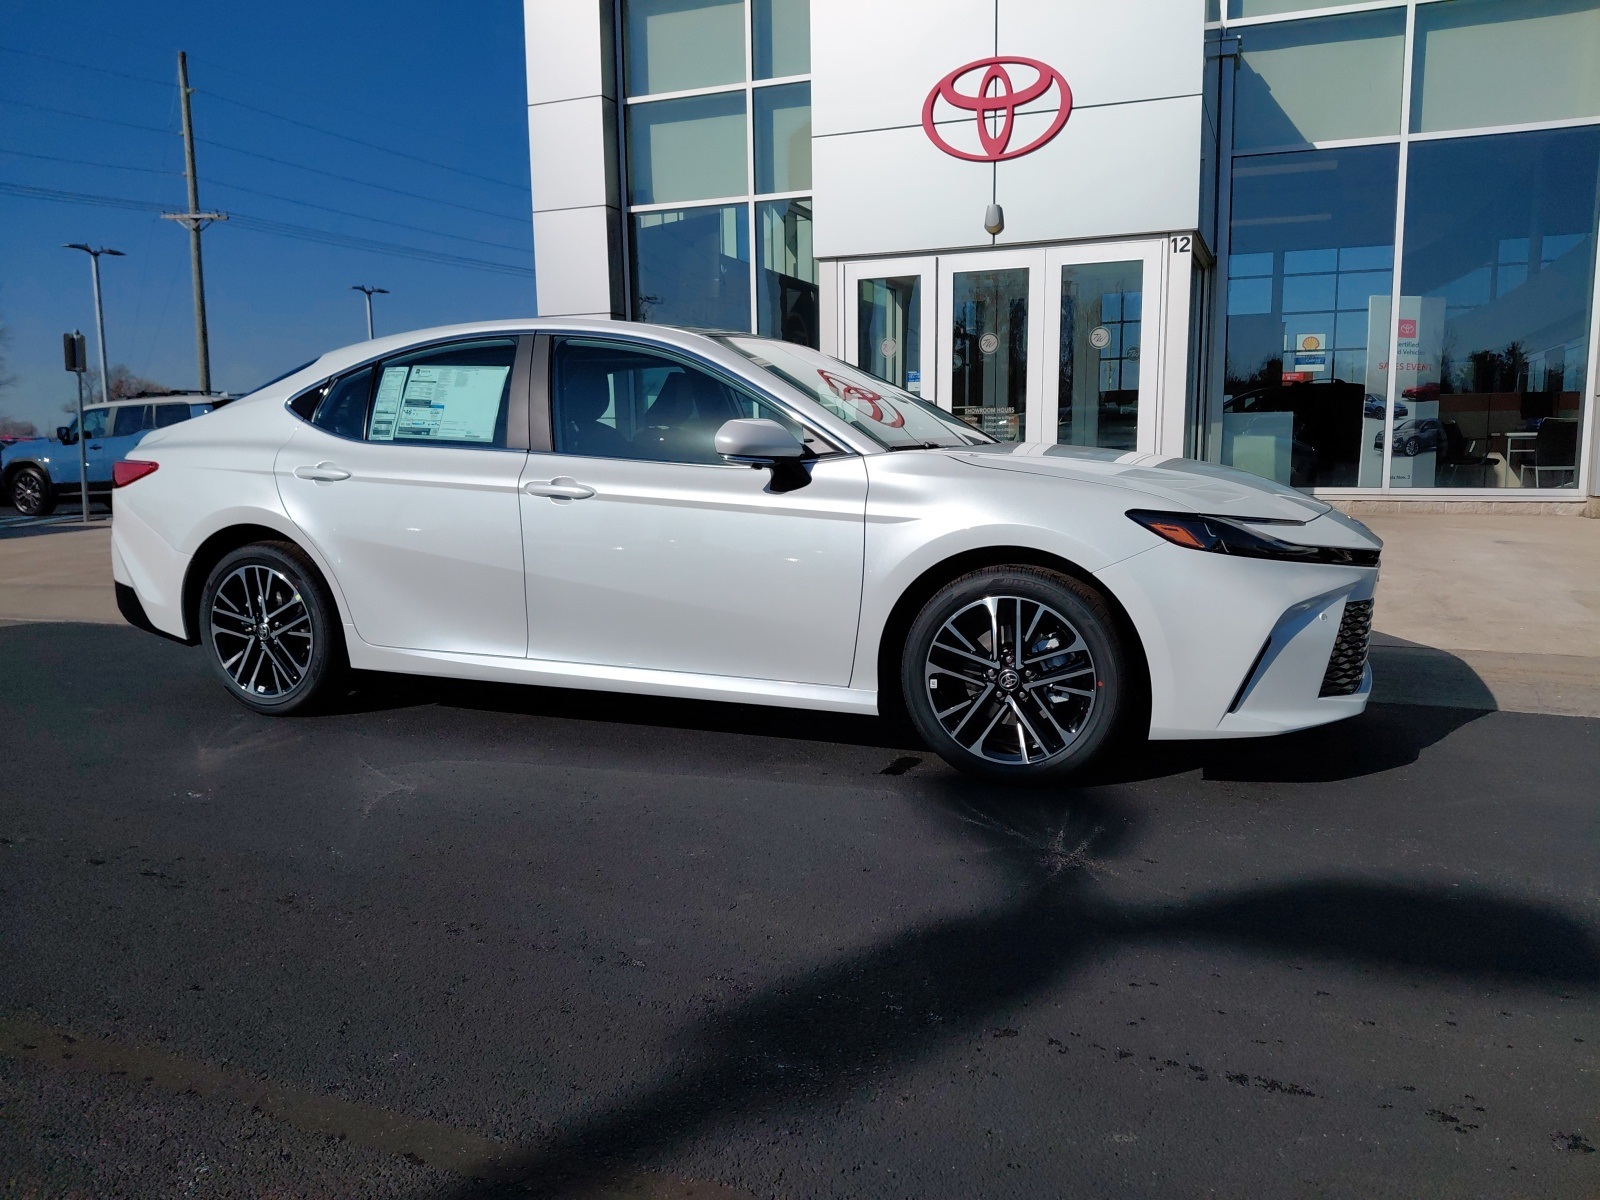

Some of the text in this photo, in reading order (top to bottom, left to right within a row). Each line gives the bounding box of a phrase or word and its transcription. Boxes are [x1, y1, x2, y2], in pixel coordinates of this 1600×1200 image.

[1171, 236, 1191, 253] 12
[1378, 362, 1432, 371] SAES EVENT
